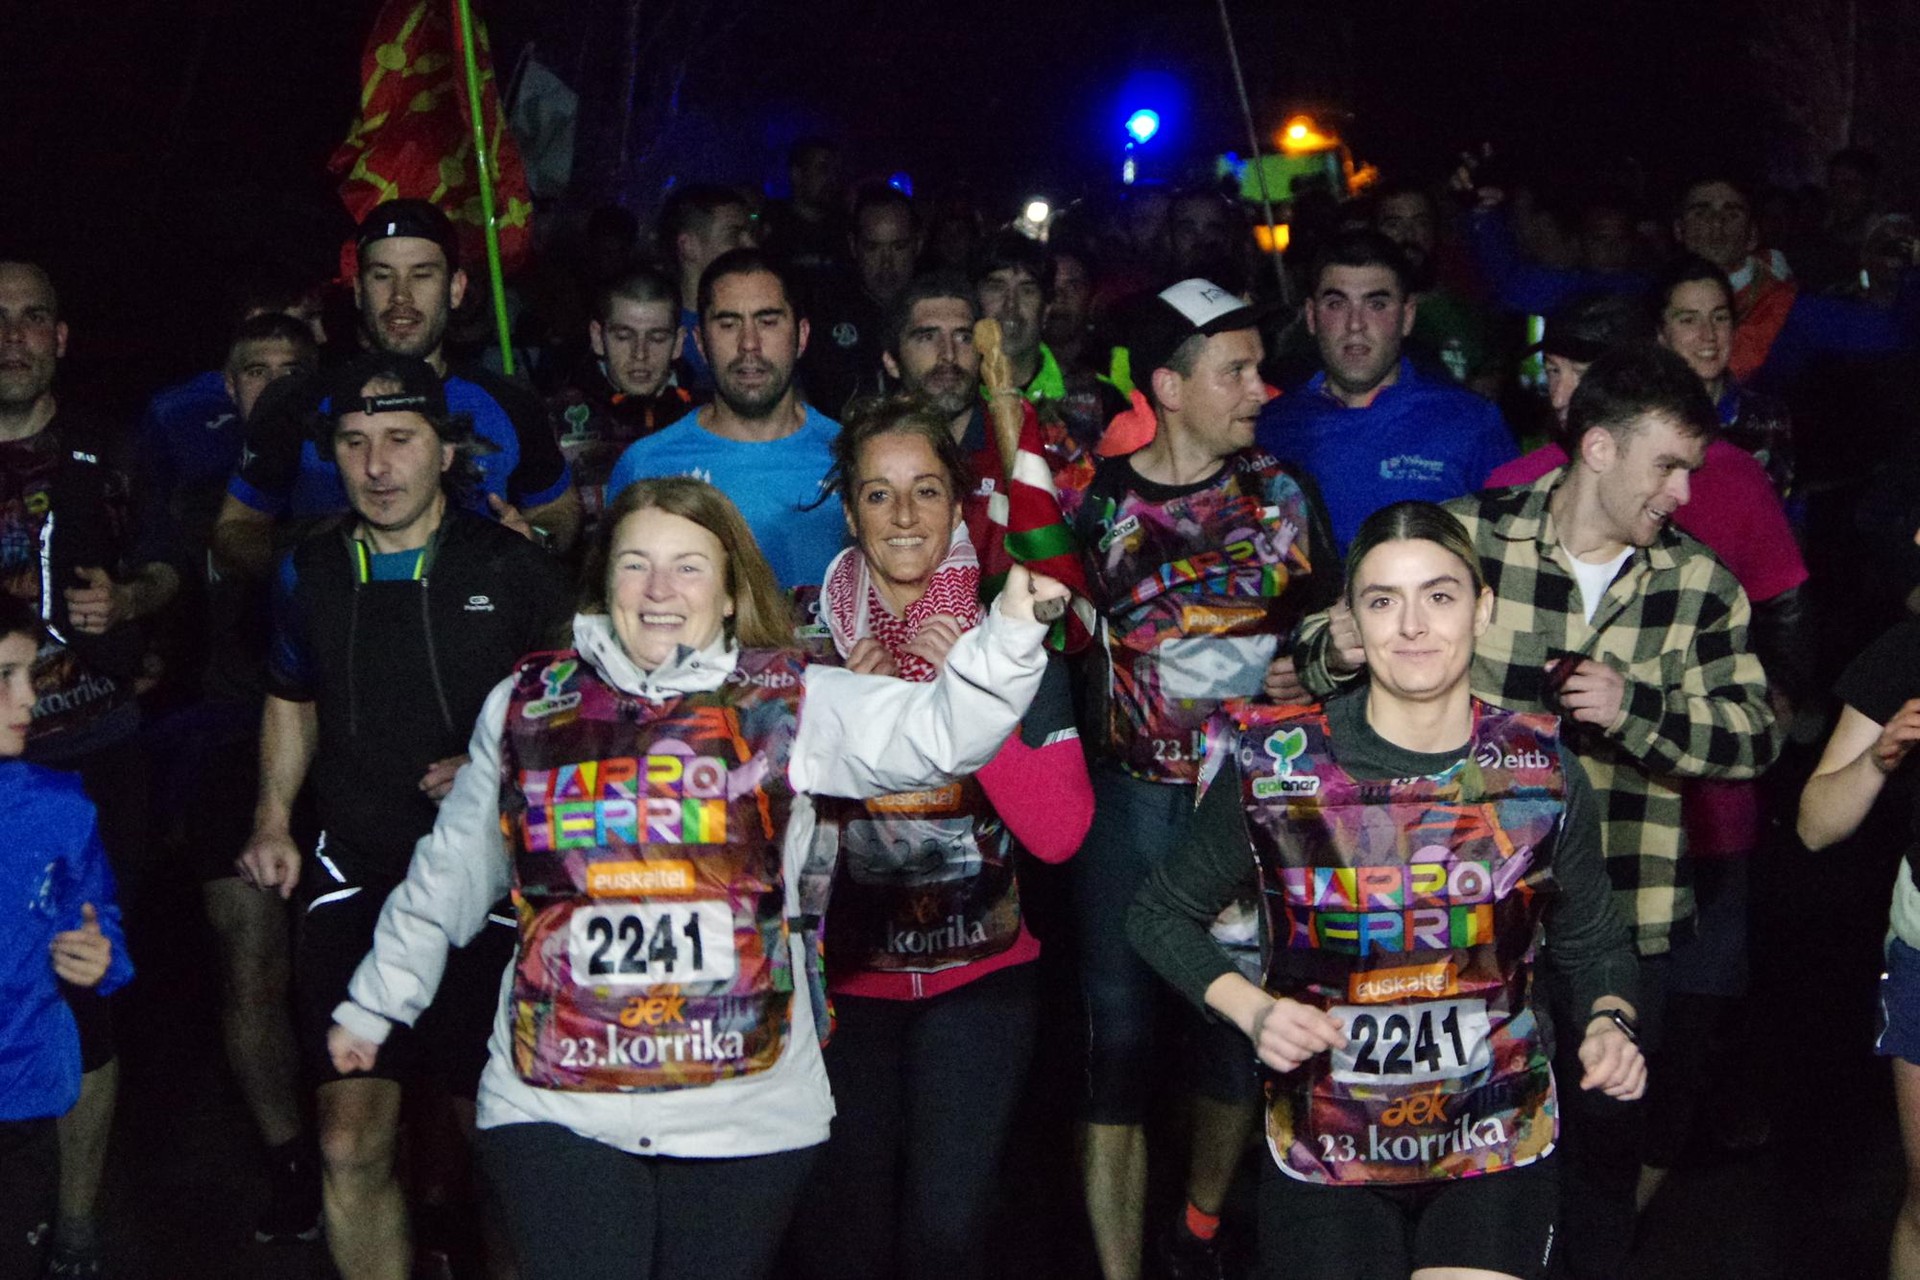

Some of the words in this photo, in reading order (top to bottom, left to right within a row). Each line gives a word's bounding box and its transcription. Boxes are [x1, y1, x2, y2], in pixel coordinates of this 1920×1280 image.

[1503, 748, 1550, 769] eitb
[586, 911, 704, 977] 2241
[1356, 972, 1450, 998] euskaltel
[1350, 1005, 1468, 1076] 2241
